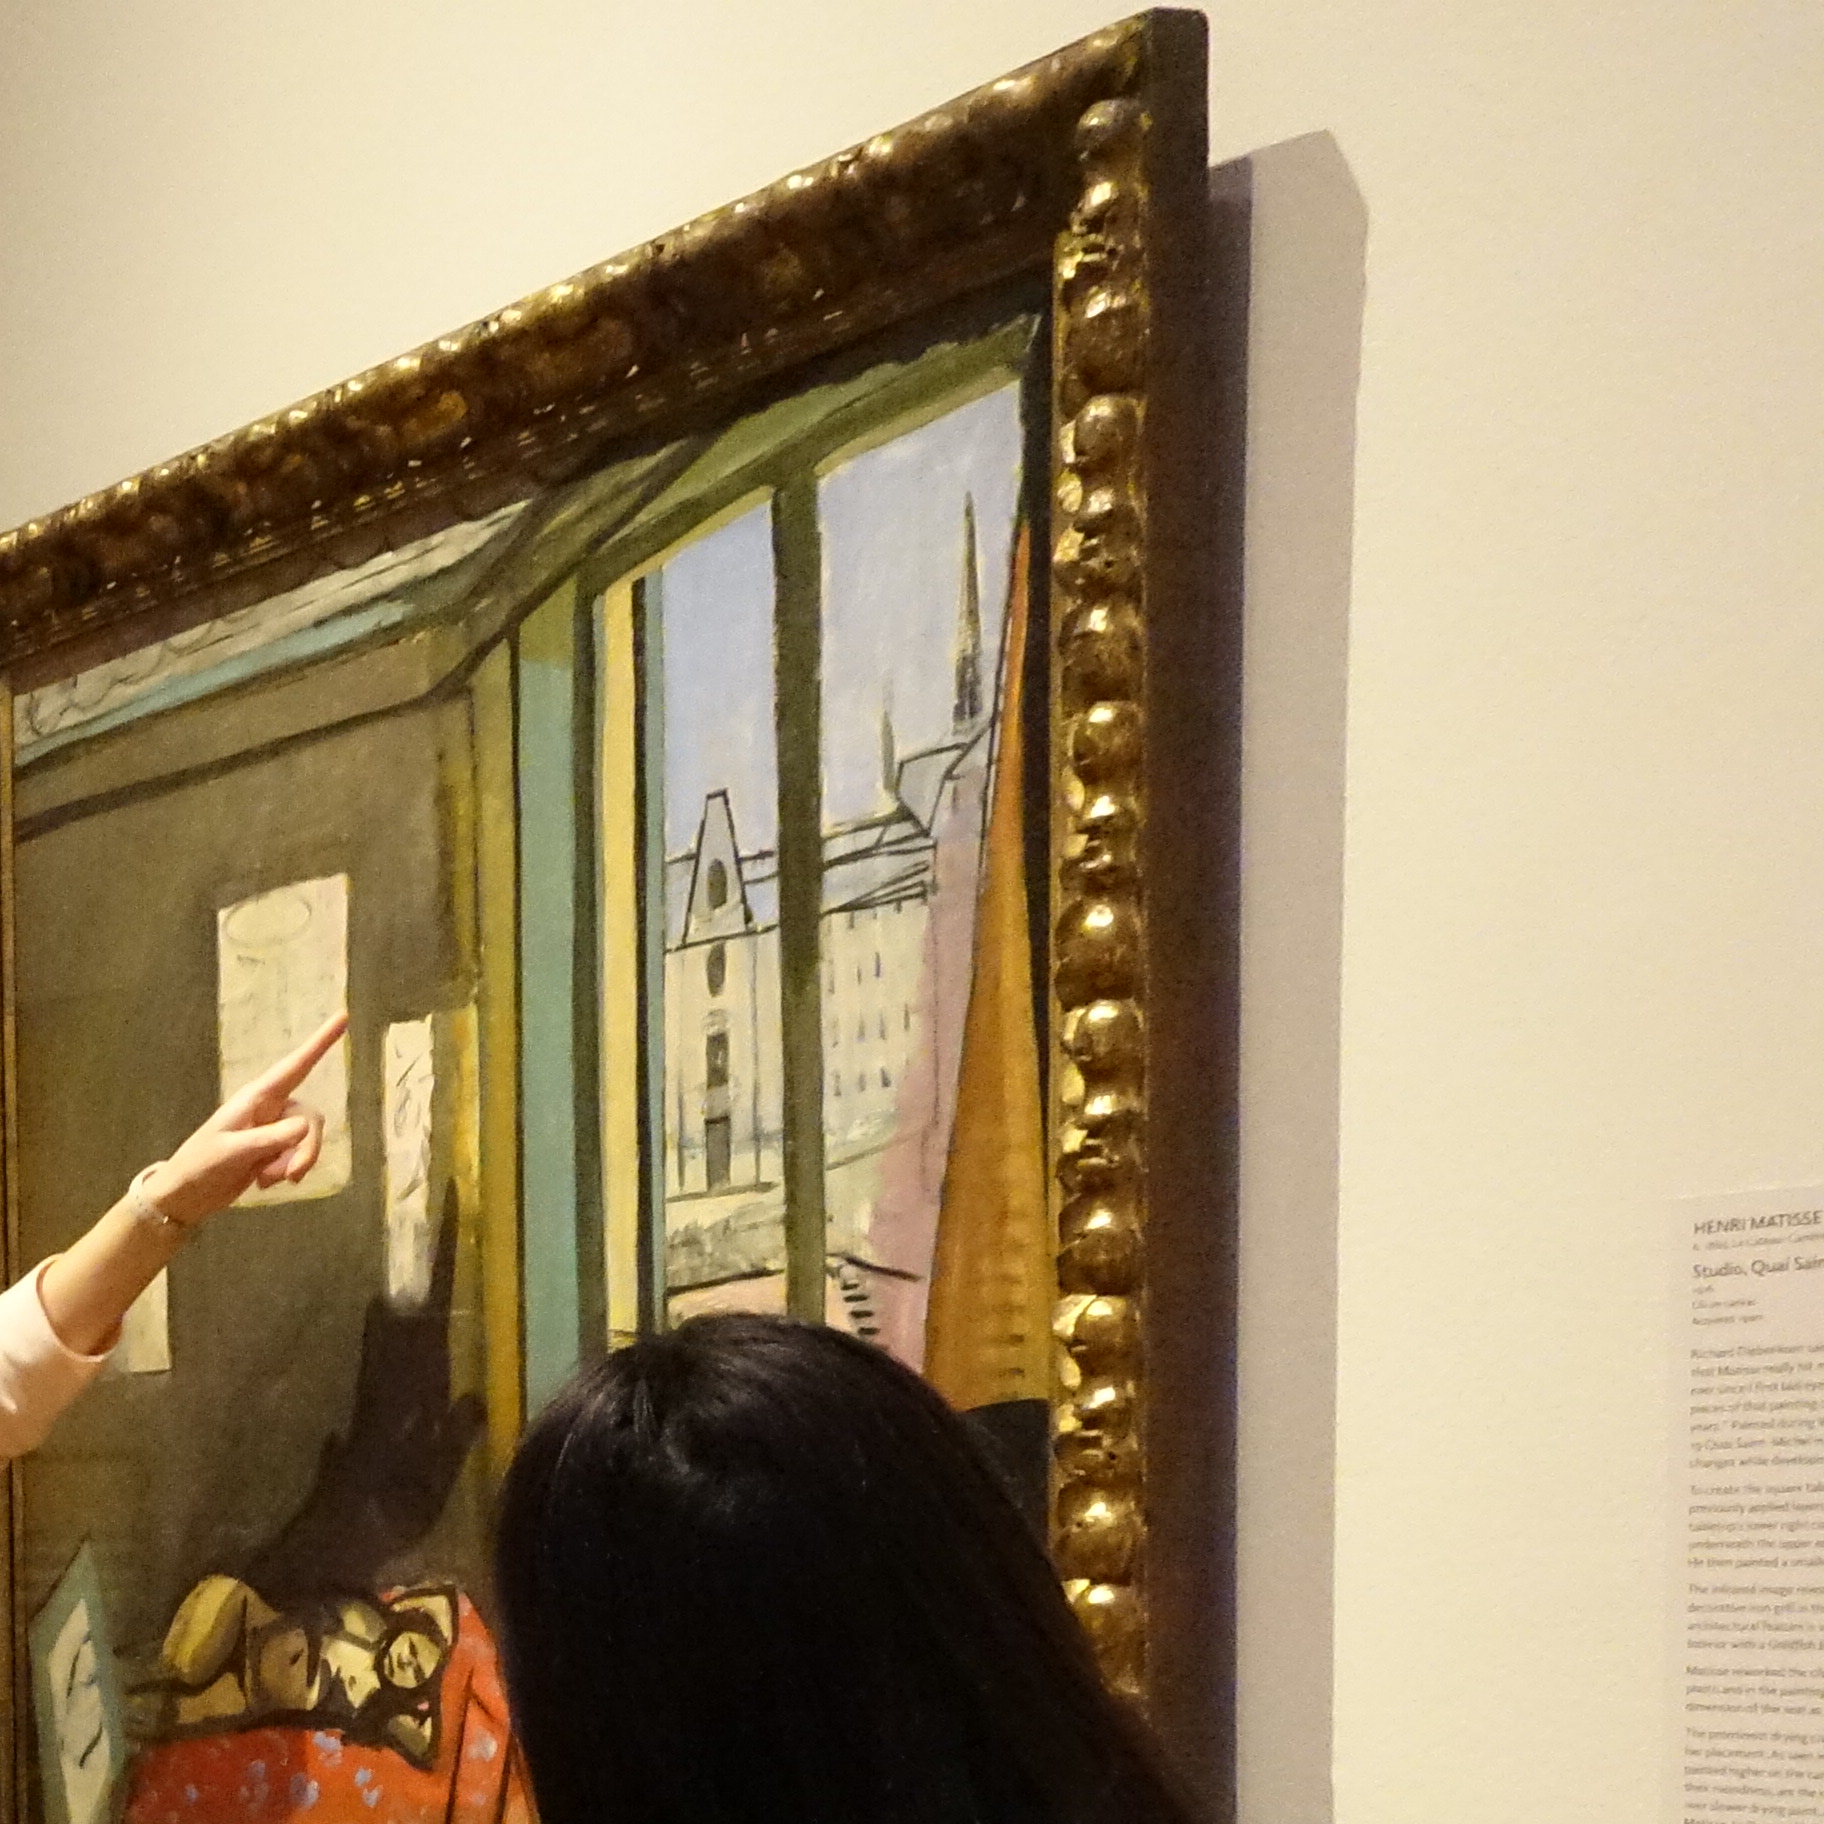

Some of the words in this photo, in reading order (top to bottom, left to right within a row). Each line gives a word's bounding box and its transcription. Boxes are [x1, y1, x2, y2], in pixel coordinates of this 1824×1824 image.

[1694, 1218, 1745, 1235] HENRI
[1750, 1210, 1822, 1229] MATISSE
[1693, 1262, 1747, 1278] Studio,
[1751, 1257, 1790, 1277] Quai
